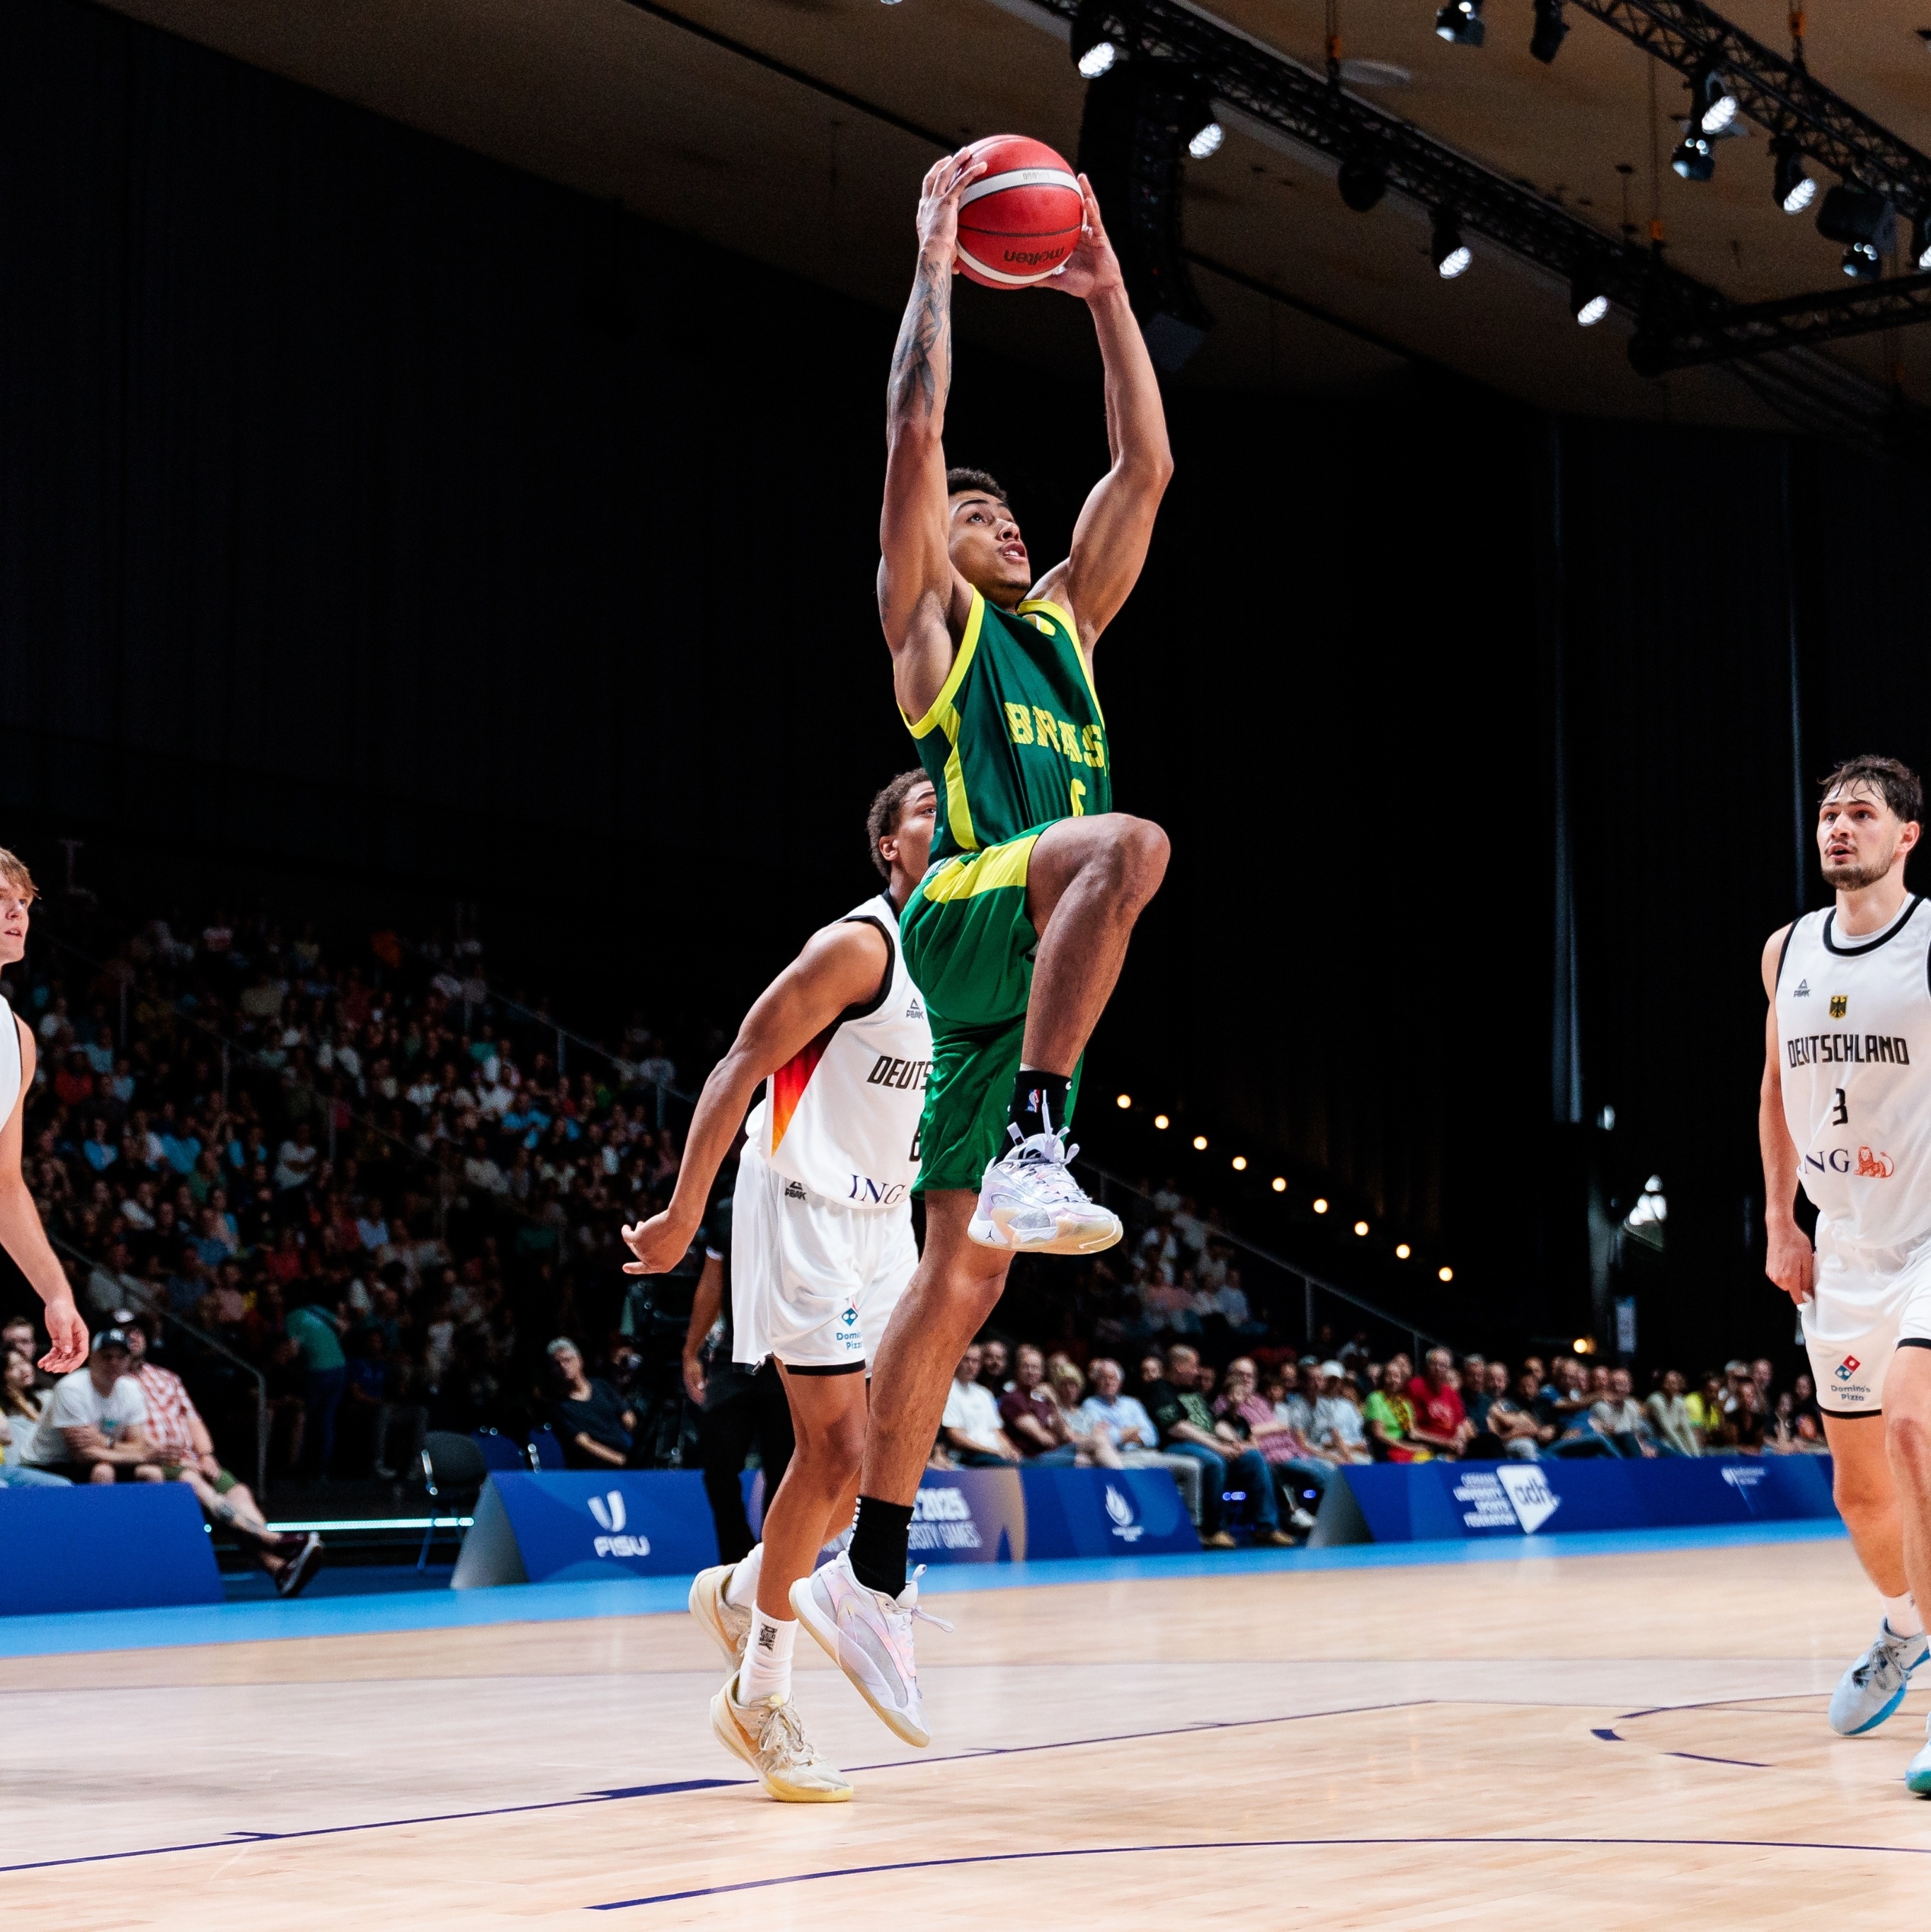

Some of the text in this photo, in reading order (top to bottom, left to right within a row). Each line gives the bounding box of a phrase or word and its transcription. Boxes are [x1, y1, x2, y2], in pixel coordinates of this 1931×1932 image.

[1003, 247, 1065, 266] molten
[1004, 701, 1106, 769] BRAS
[1793, 989, 1811, 998] PEAK
[906, 1010, 924, 1020] PEAK
[1787, 1034, 1910, 1069] DEUTSCHLAND
[1832, 1088, 1849, 1127] 3
[1799, 1149, 1850, 1175] NG
[784, 1188, 807, 1201] PEAK
[848, 1173, 906, 1204] ING
[846, 1341, 862, 1350] Pizz
[1830, 1384, 1871, 1393] Domino's
[1841, 1393, 1865, 1401] Pizza
[918, 1488, 972, 1521] 2025
[594, 1535, 651, 1558] FISU
[938, 1522, 982, 1549] GAMES
